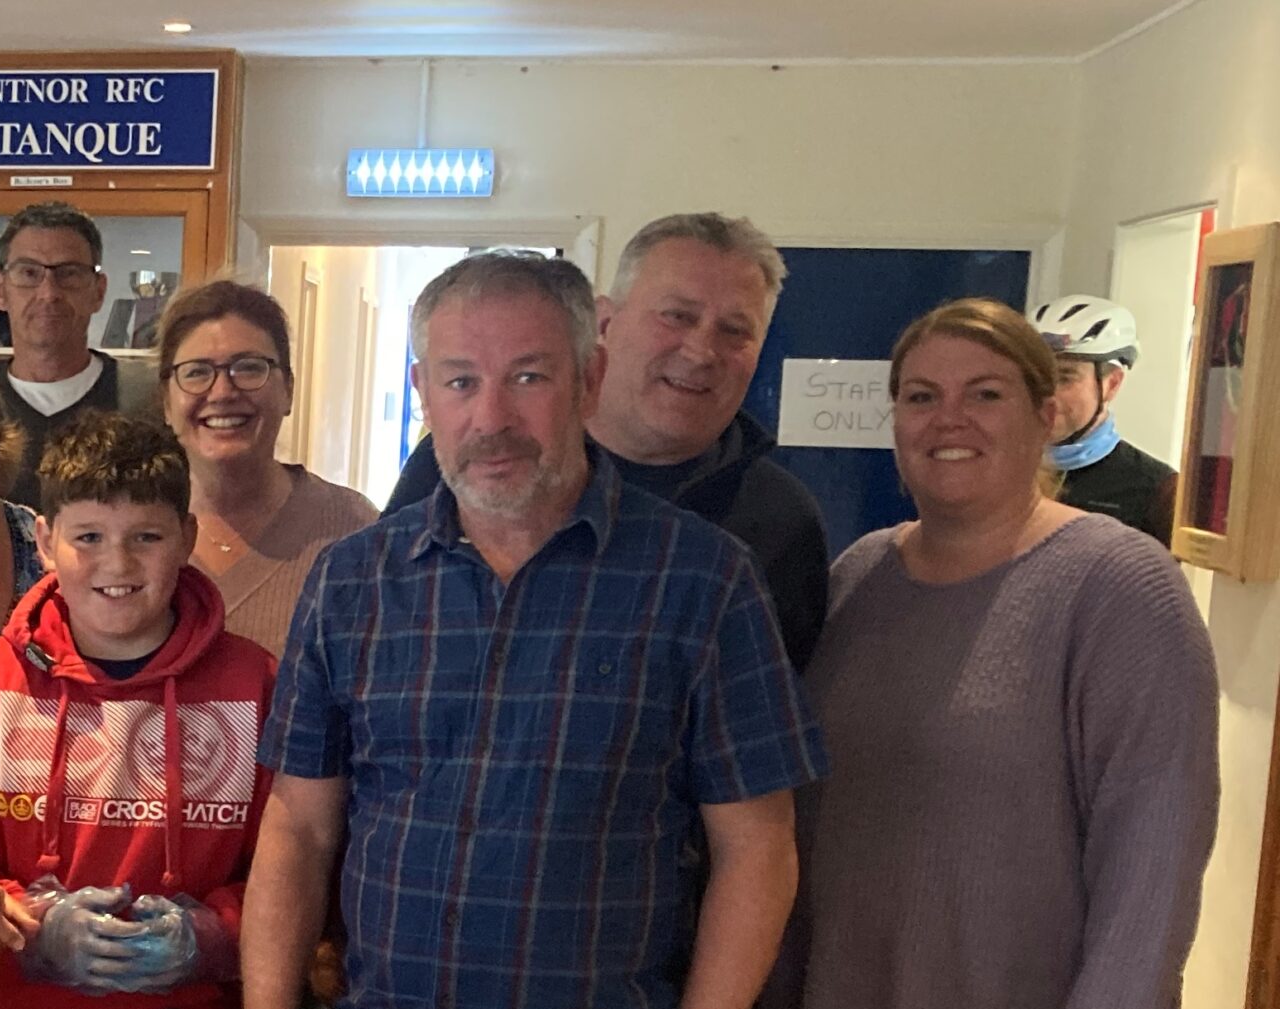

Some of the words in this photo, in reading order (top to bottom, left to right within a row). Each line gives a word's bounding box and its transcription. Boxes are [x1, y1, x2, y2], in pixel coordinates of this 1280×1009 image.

[106, 78, 164, 103] RFC
[805, 372, 884, 400] STAF
[814, 408, 893, 431] ONLY
[103, 800, 248, 823] CROSHATCH
